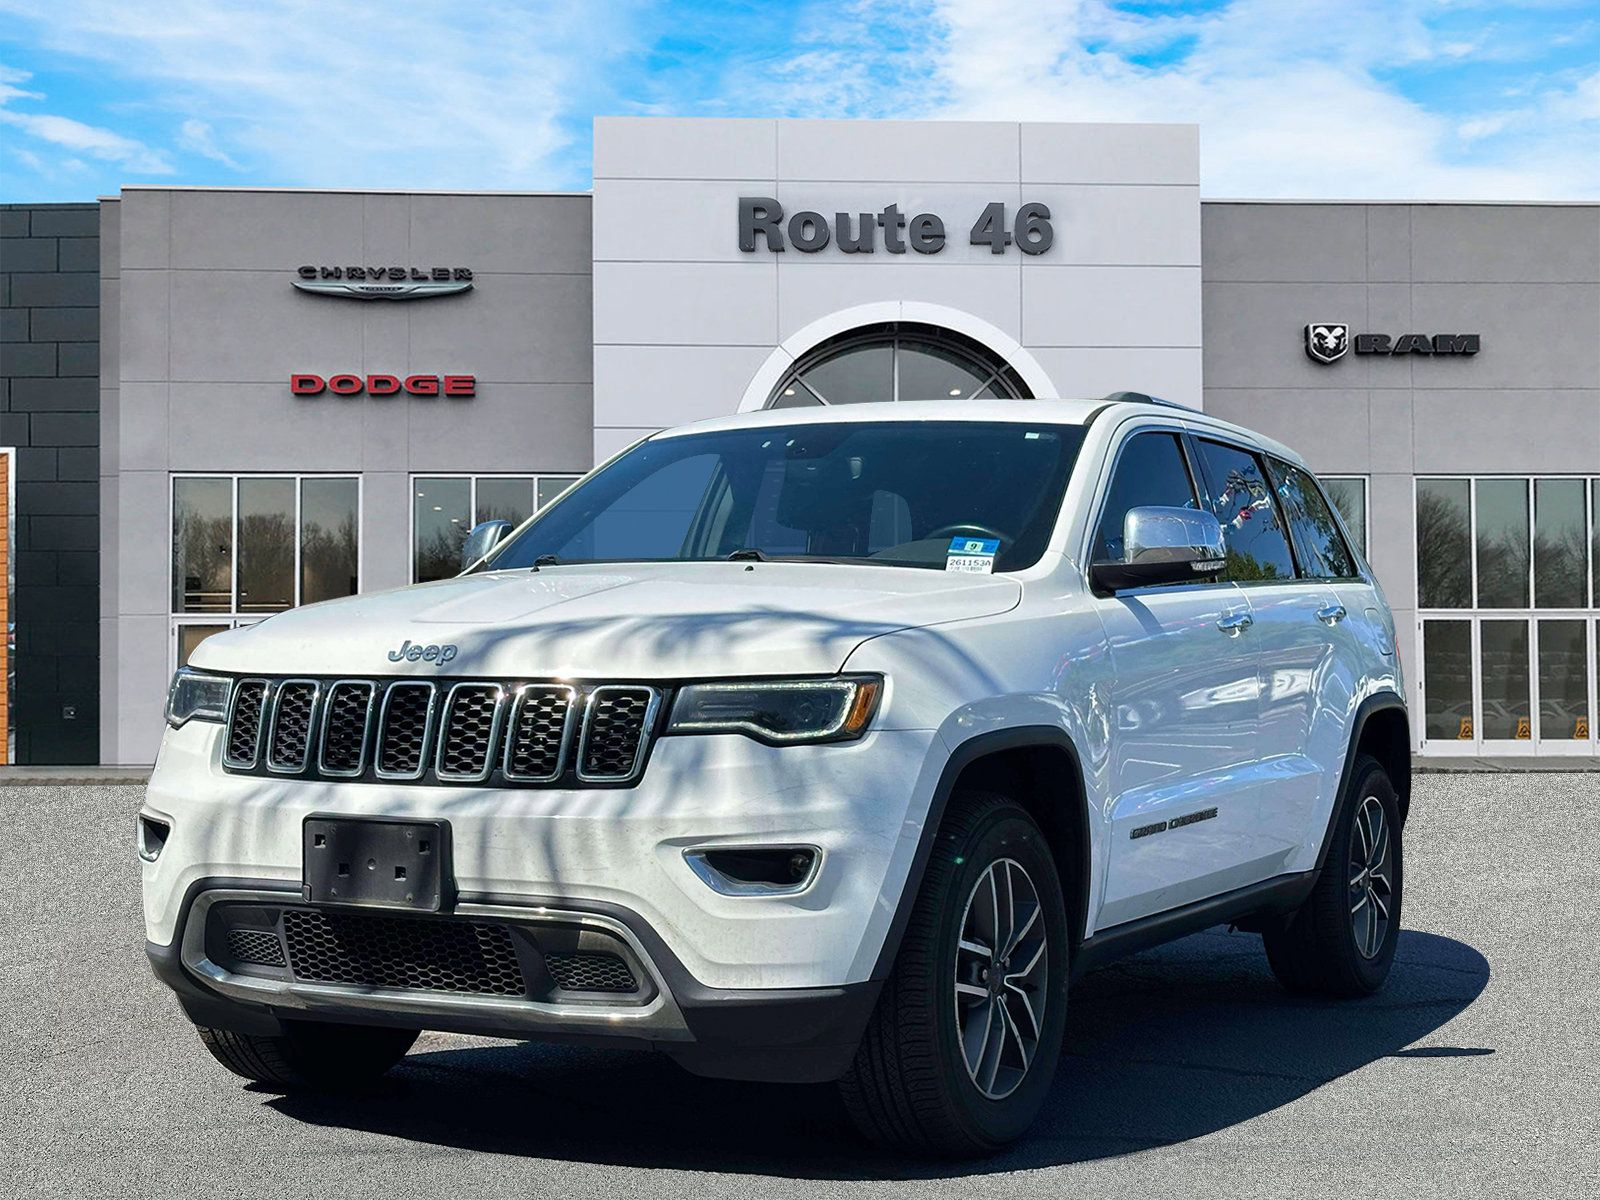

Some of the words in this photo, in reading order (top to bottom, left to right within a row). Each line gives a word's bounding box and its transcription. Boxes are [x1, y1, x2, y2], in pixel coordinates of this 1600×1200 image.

[739, 197, 946, 254] Route
[970, 202, 1054, 255] 46
[298, 266, 472, 280] CHRYSLER
[1355, 334, 1480, 356] RAM
[291, 374, 476, 397] DODGE
[969, 542, 978, 551] 9
[388, 640, 458, 666] Jeep
